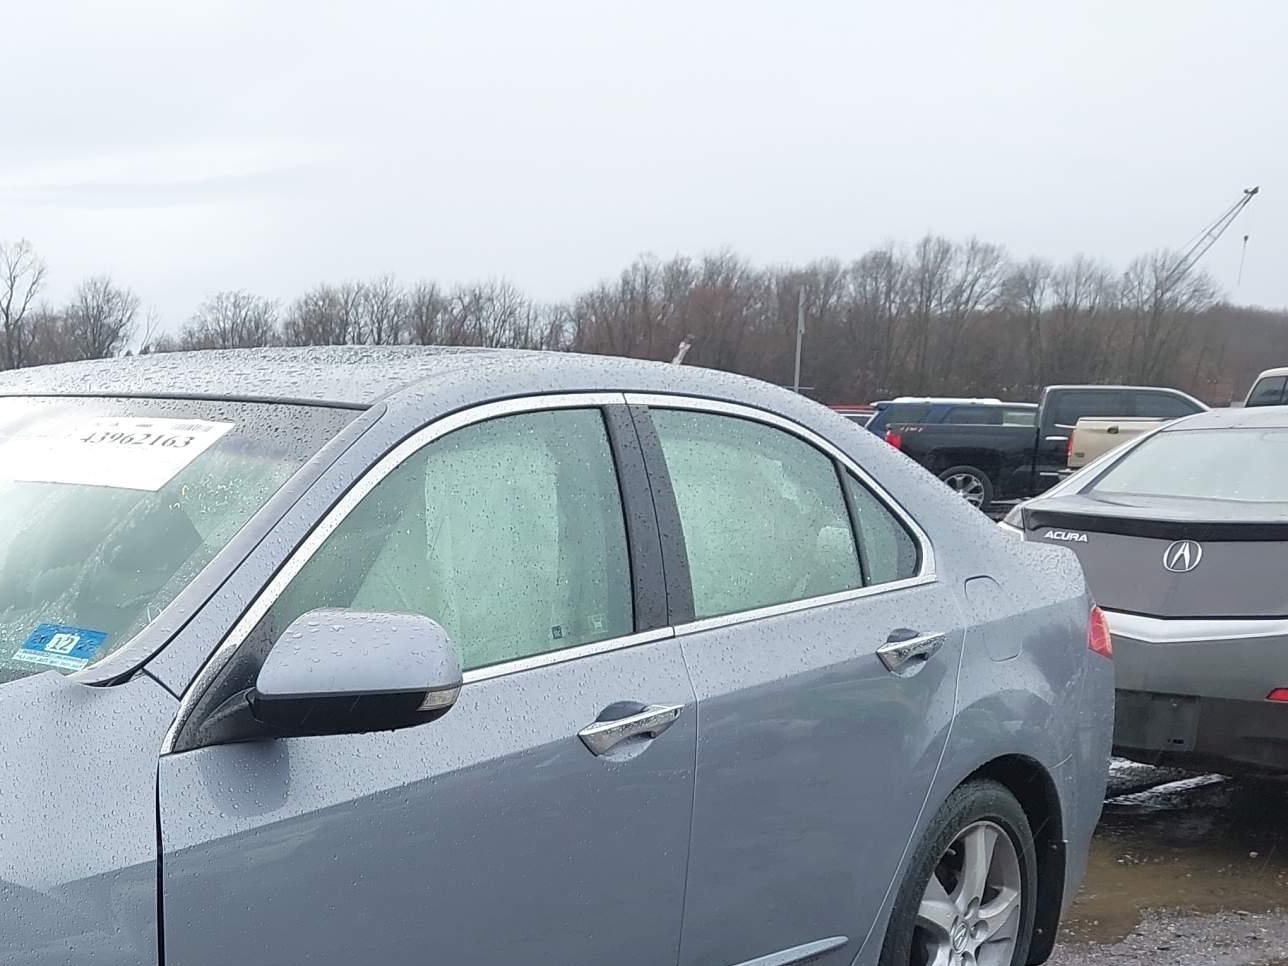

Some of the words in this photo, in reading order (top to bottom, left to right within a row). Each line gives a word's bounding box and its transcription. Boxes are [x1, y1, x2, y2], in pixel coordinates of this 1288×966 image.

[80, 432, 196, 448] 43962163
[1044, 530, 1088, 542] ACURA
[51, 636, 75, 651] 12
